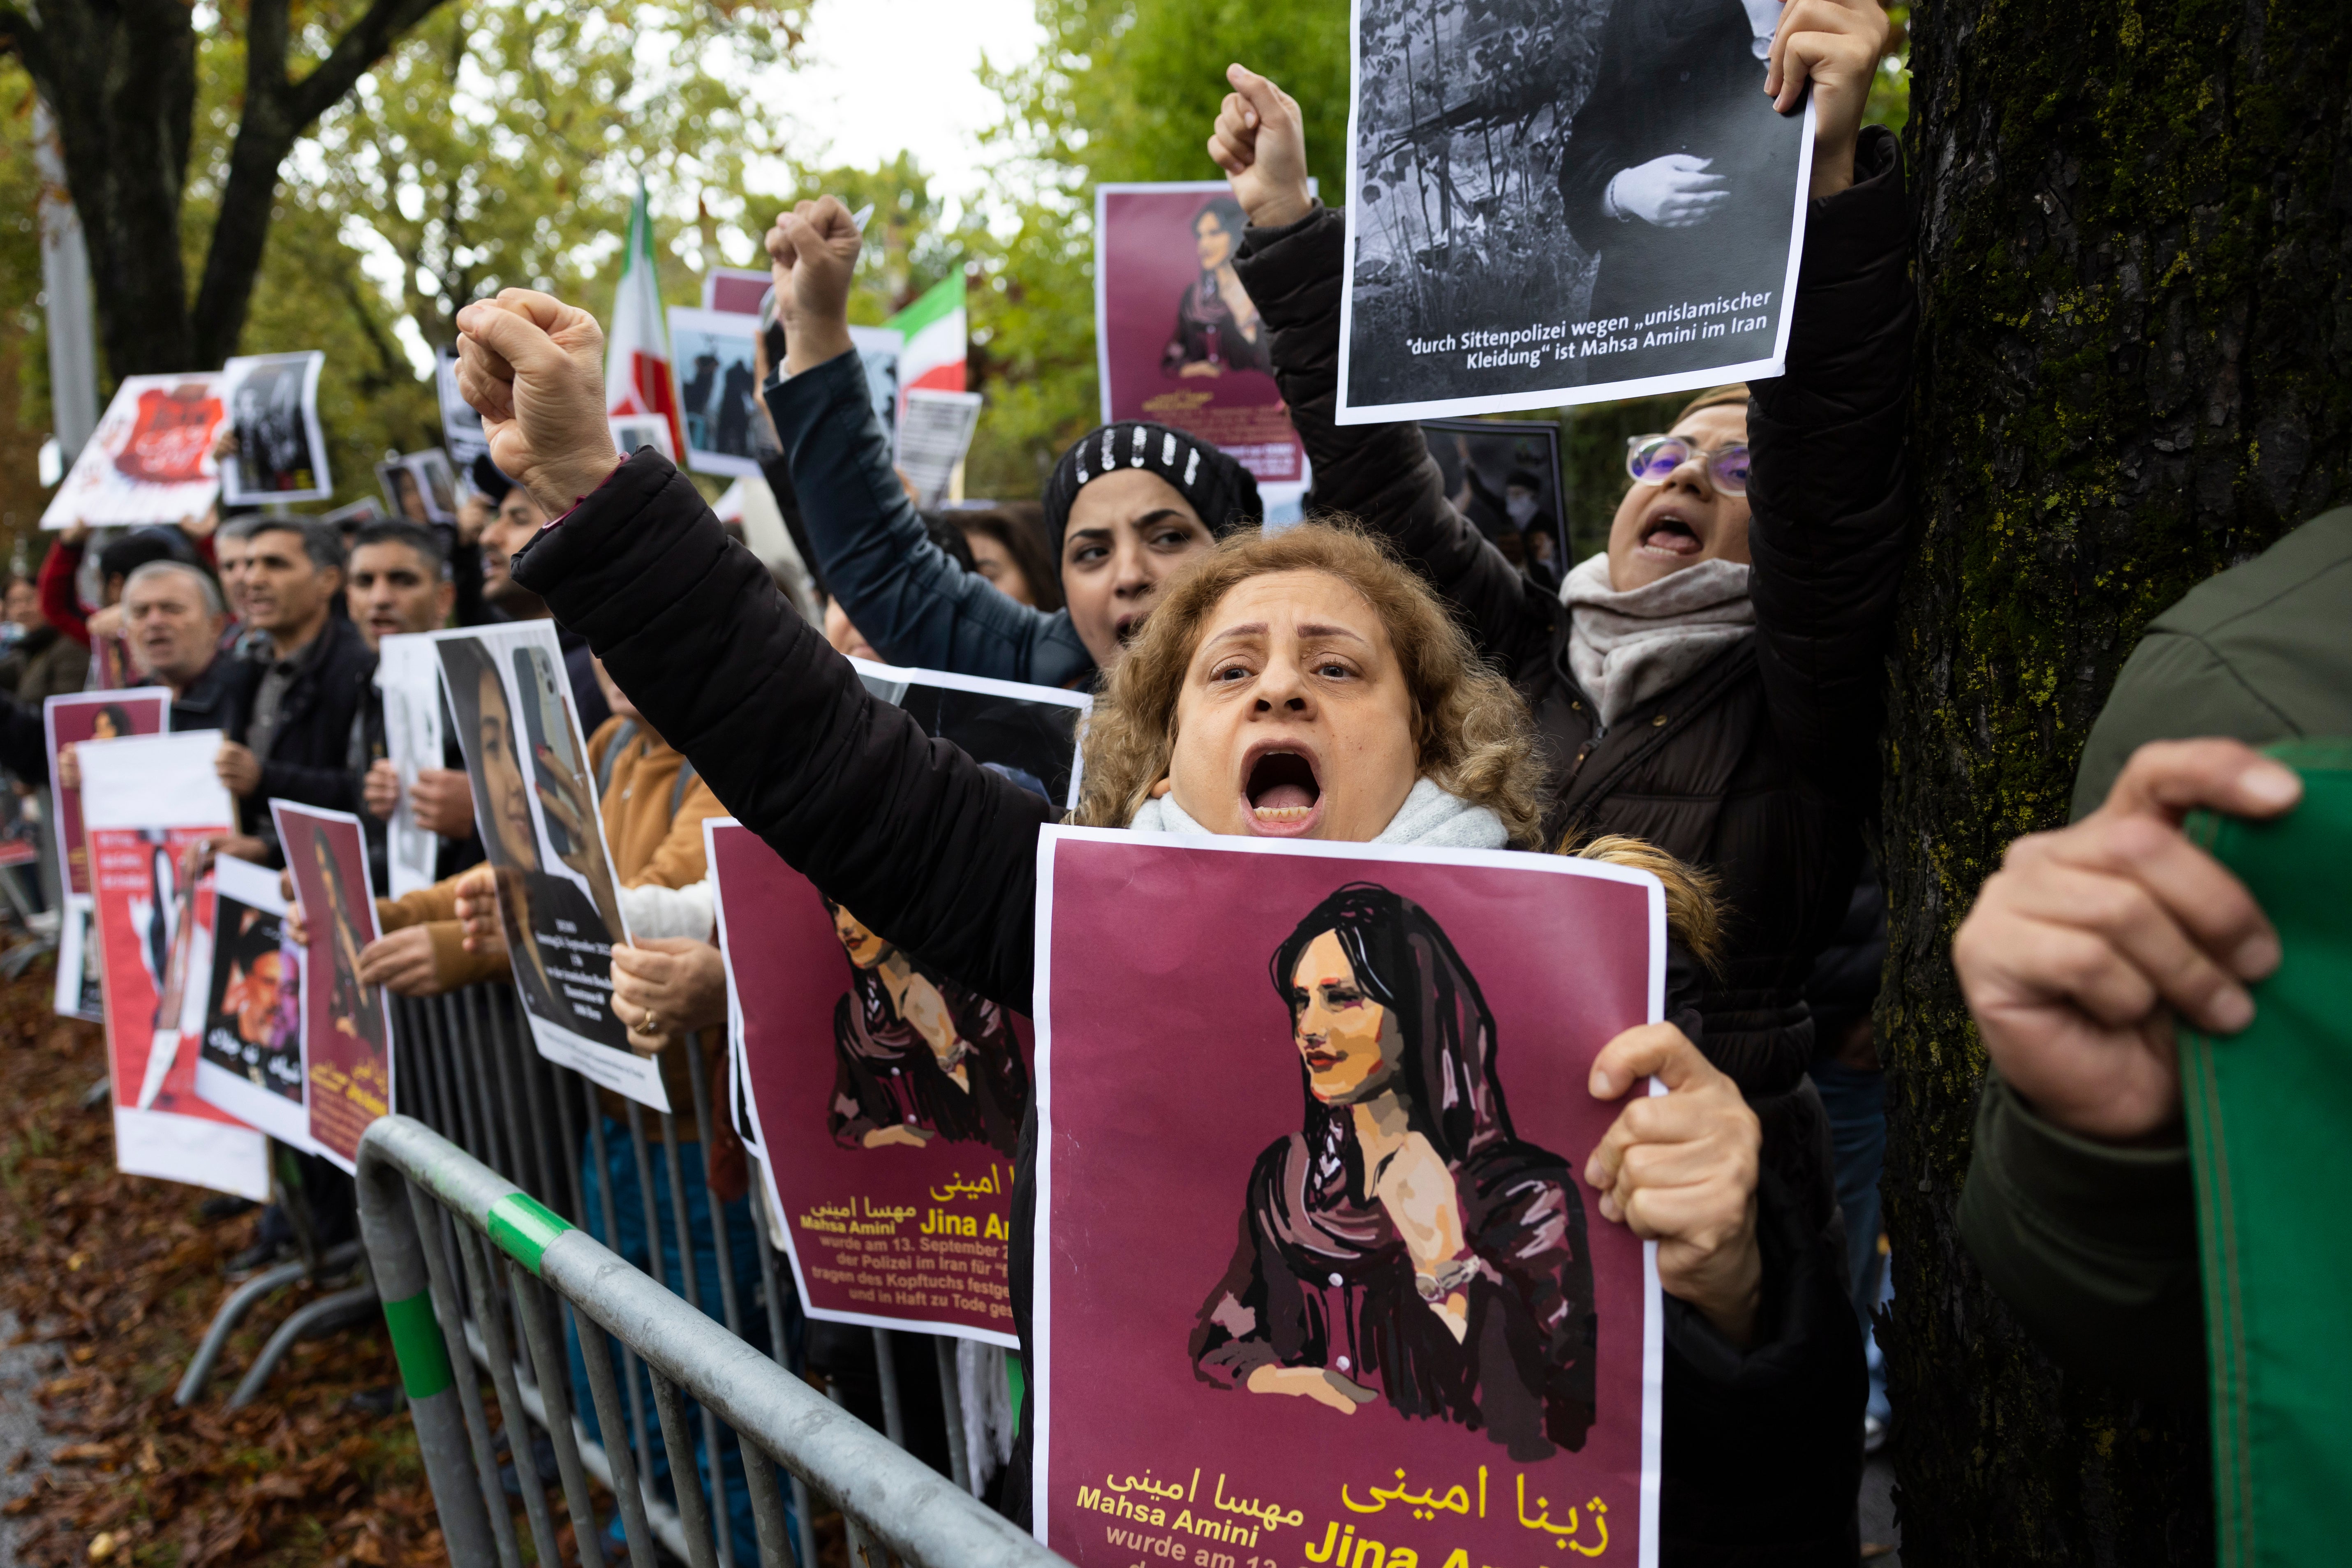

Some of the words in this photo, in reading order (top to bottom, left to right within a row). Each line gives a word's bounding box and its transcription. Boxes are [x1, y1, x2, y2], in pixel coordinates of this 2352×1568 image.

[1461, 321, 1566, 348] Sittenpolizei
[1572, 316, 1629, 337] wegen
[1635, 291, 1772, 330] „unislamischer
[1467, 344, 1549, 369] Kleidung“
[1555, 342, 1575, 360] ist
[1580, 336, 1637, 356] Mahsa
[1643, 324, 1697, 348] Amini
[1702, 321, 1725, 339] im
[1731, 316, 1767, 334] Iran
[800, 1215, 846, 1233] Mahsa
[849, 1220, 895, 1235] Amini
[864, 1196, 916, 1223] مهسا
[919, 1208, 977, 1237] Jina
[983, 1213, 1009, 1241] A
[819, 1235, 862, 1251] wurde
[864, 1240, 888, 1252] am
[892, 1237, 915, 1252] 13.
[920, 1237, 999, 1257] September
[836, 1251, 858, 1267] der
[861, 1254, 912, 1270] Polizei
[916, 1255, 935, 1270] im
[939, 1256, 967, 1272] Iran
[971, 1259, 992, 1276] für
[848, 1288, 875, 1302] und
[878, 1289, 892, 1304] in
[895, 1291, 927, 1306] Haft
[930, 1295, 948, 1307] zu
[952, 1293, 987, 1313] Tode
[857, 1271, 883, 1286] des
[886, 1273, 964, 1291] Kopftuchs
[967, 1277, 1009, 1300] festge
[1107, 1468, 1200, 1502] امینی
[1214, 1473, 1304, 1531] مهسا
[1342, 1465, 1487, 1521] امینی
[1076, 1485, 1166, 1526] Mahsa
[1172, 1509, 1259, 1548] Amini
[1517, 1473, 1608, 1556] ژینا
[1106, 1526, 1186, 1561] wurde
[1194, 1549, 1235, 1568] am
[1305, 1521, 1418, 1568] Jina
